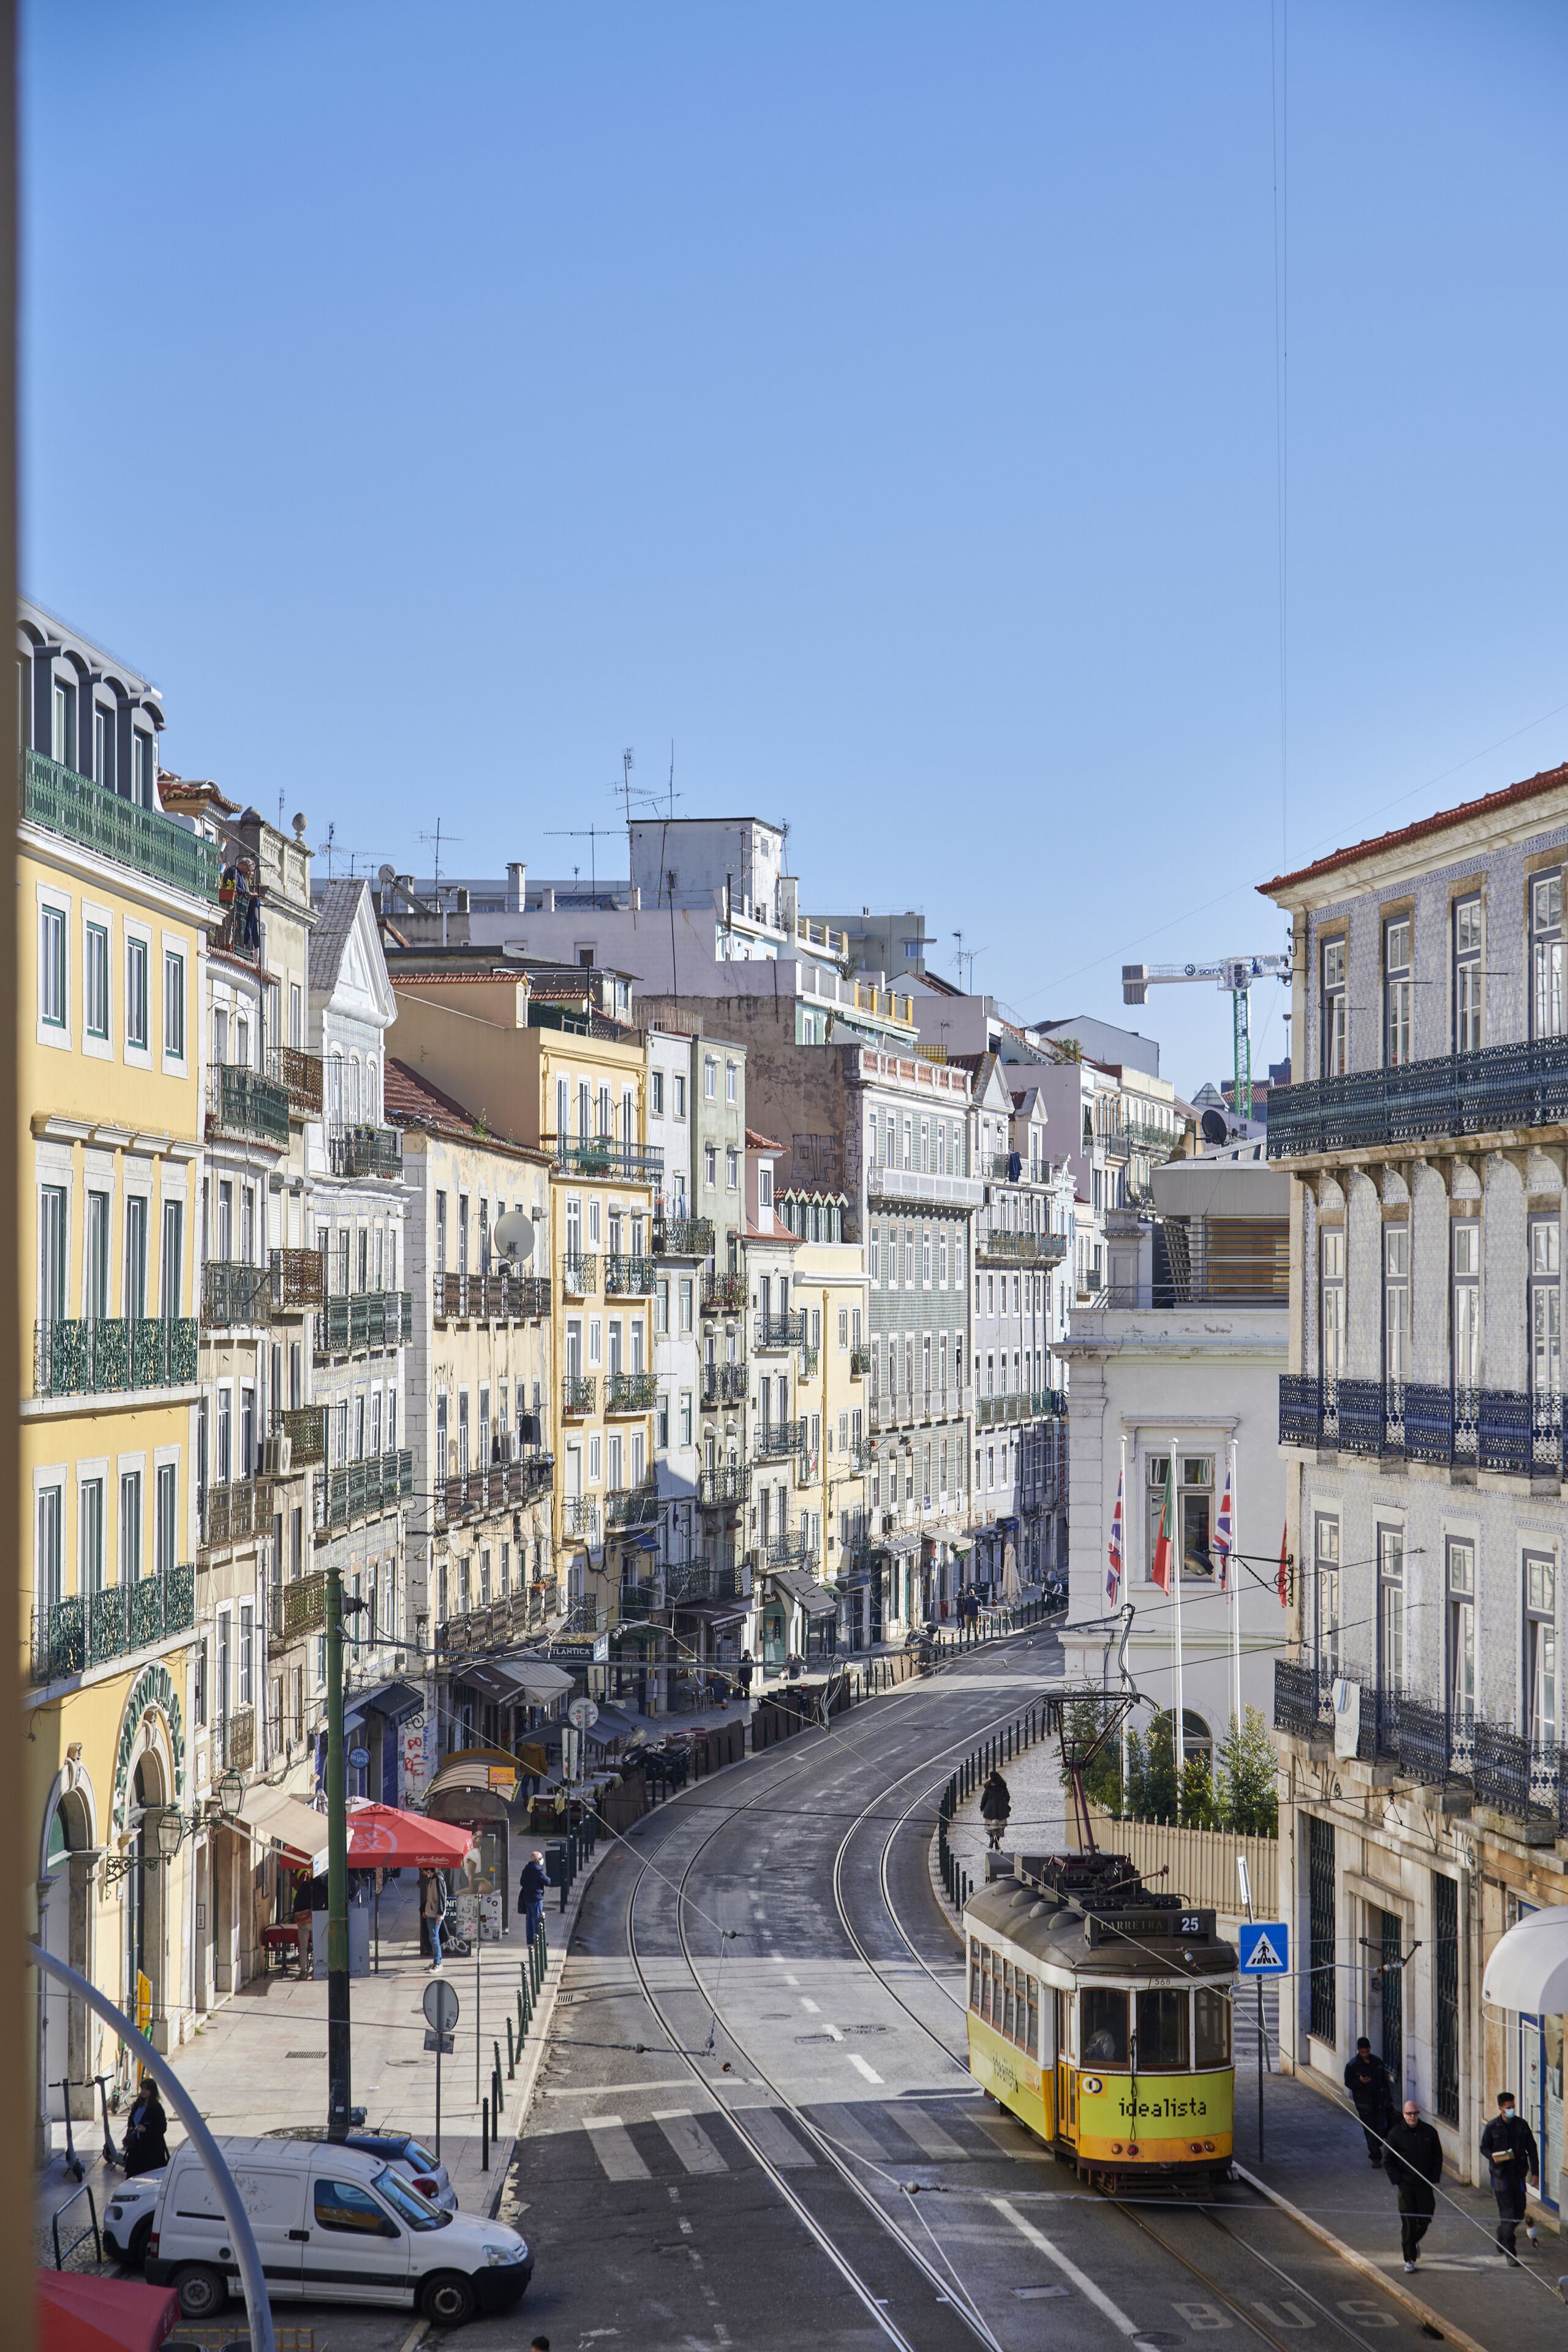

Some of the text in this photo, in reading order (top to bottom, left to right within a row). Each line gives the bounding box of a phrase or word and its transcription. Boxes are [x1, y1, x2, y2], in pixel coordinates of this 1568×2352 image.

[350, 1752, 368, 1763] BLUES
[1101, 1917, 1199, 1931] CARREIRA 25
[1118, 2097, 1207, 2117] idealista
[1170, 2300, 1400, 2330] BUS
